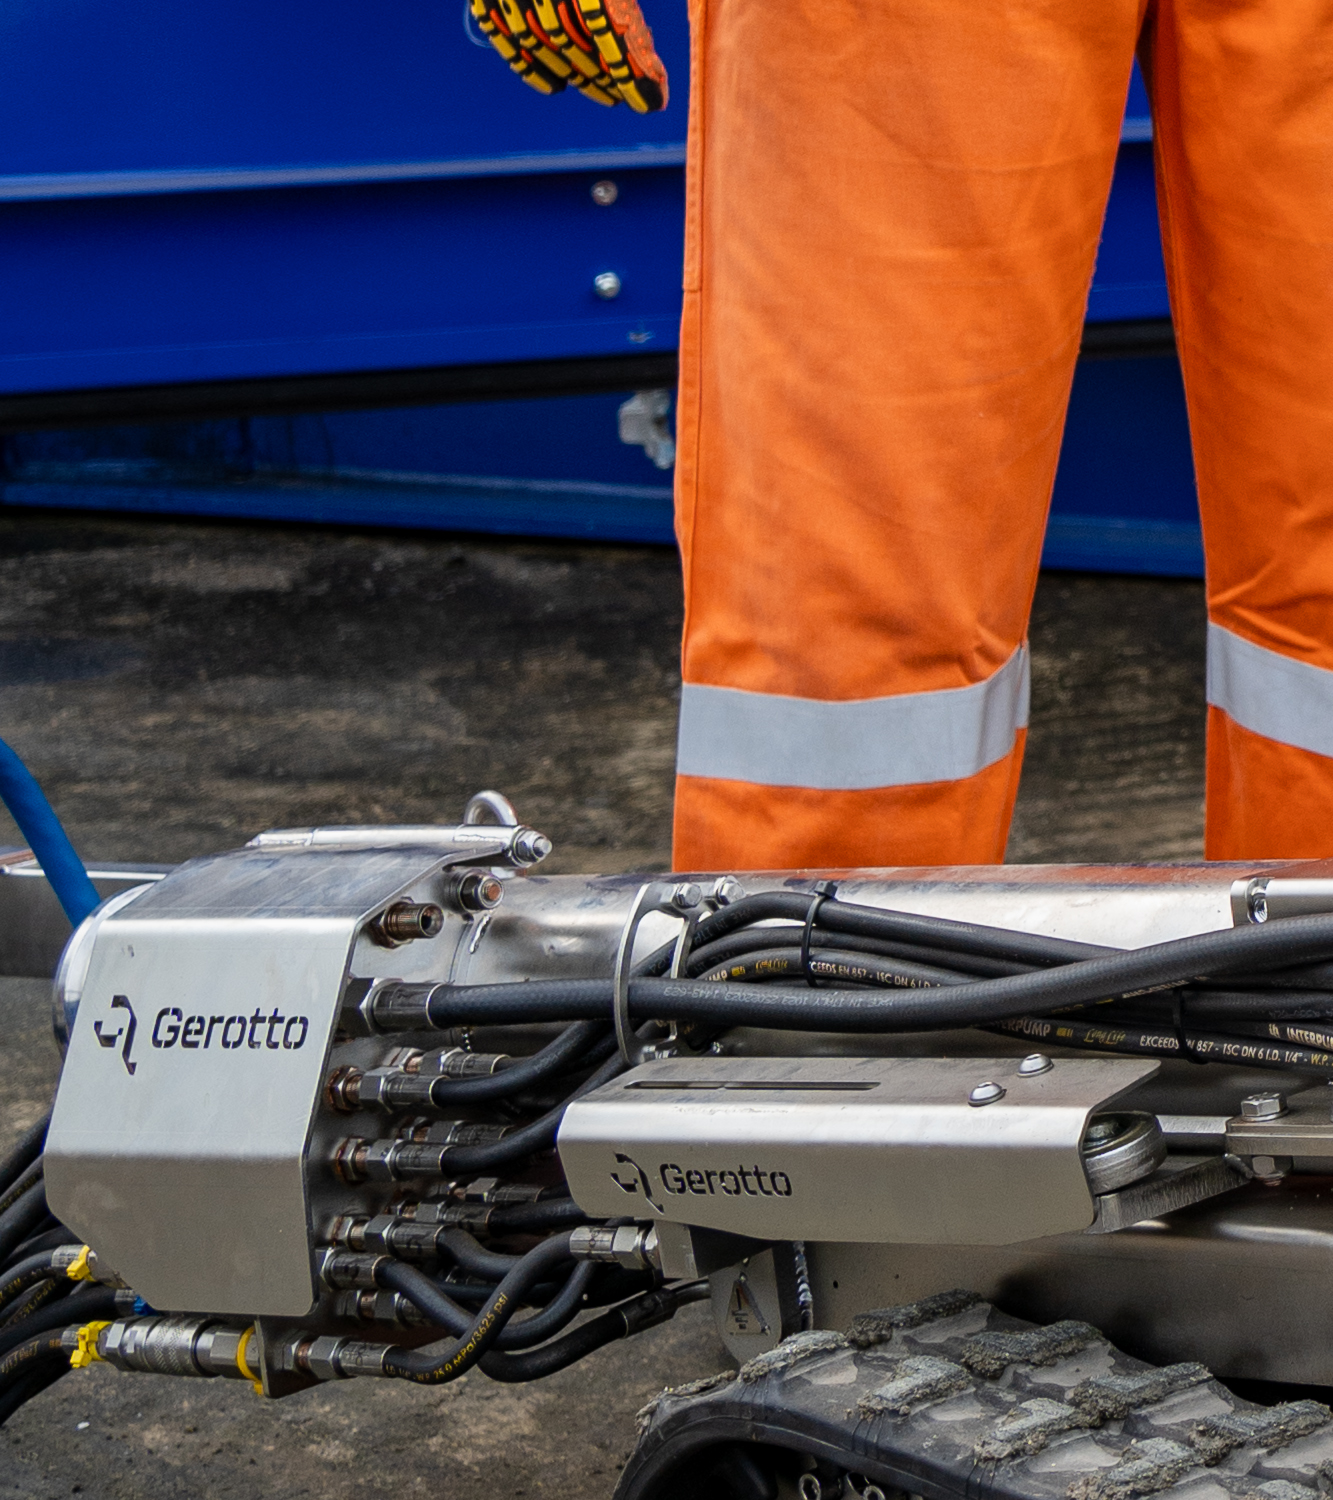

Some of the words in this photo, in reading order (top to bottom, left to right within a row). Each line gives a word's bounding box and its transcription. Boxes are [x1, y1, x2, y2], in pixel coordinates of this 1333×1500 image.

[151, 1007, 308, 1049] Gerotto
[1139, 1035, 1179, 1049] EXCEEDS
[1196, 1041, 1212, 1052] 857
[1241, 1046, 1255, 1058] DN
[1266, 1049, 1281, 1061] I.D.
[1310, 1054, 1329, 1066] W.P.
[659, 1163, 792, 1196] Gerotto
[493, 1292, 508, 1314] psi
